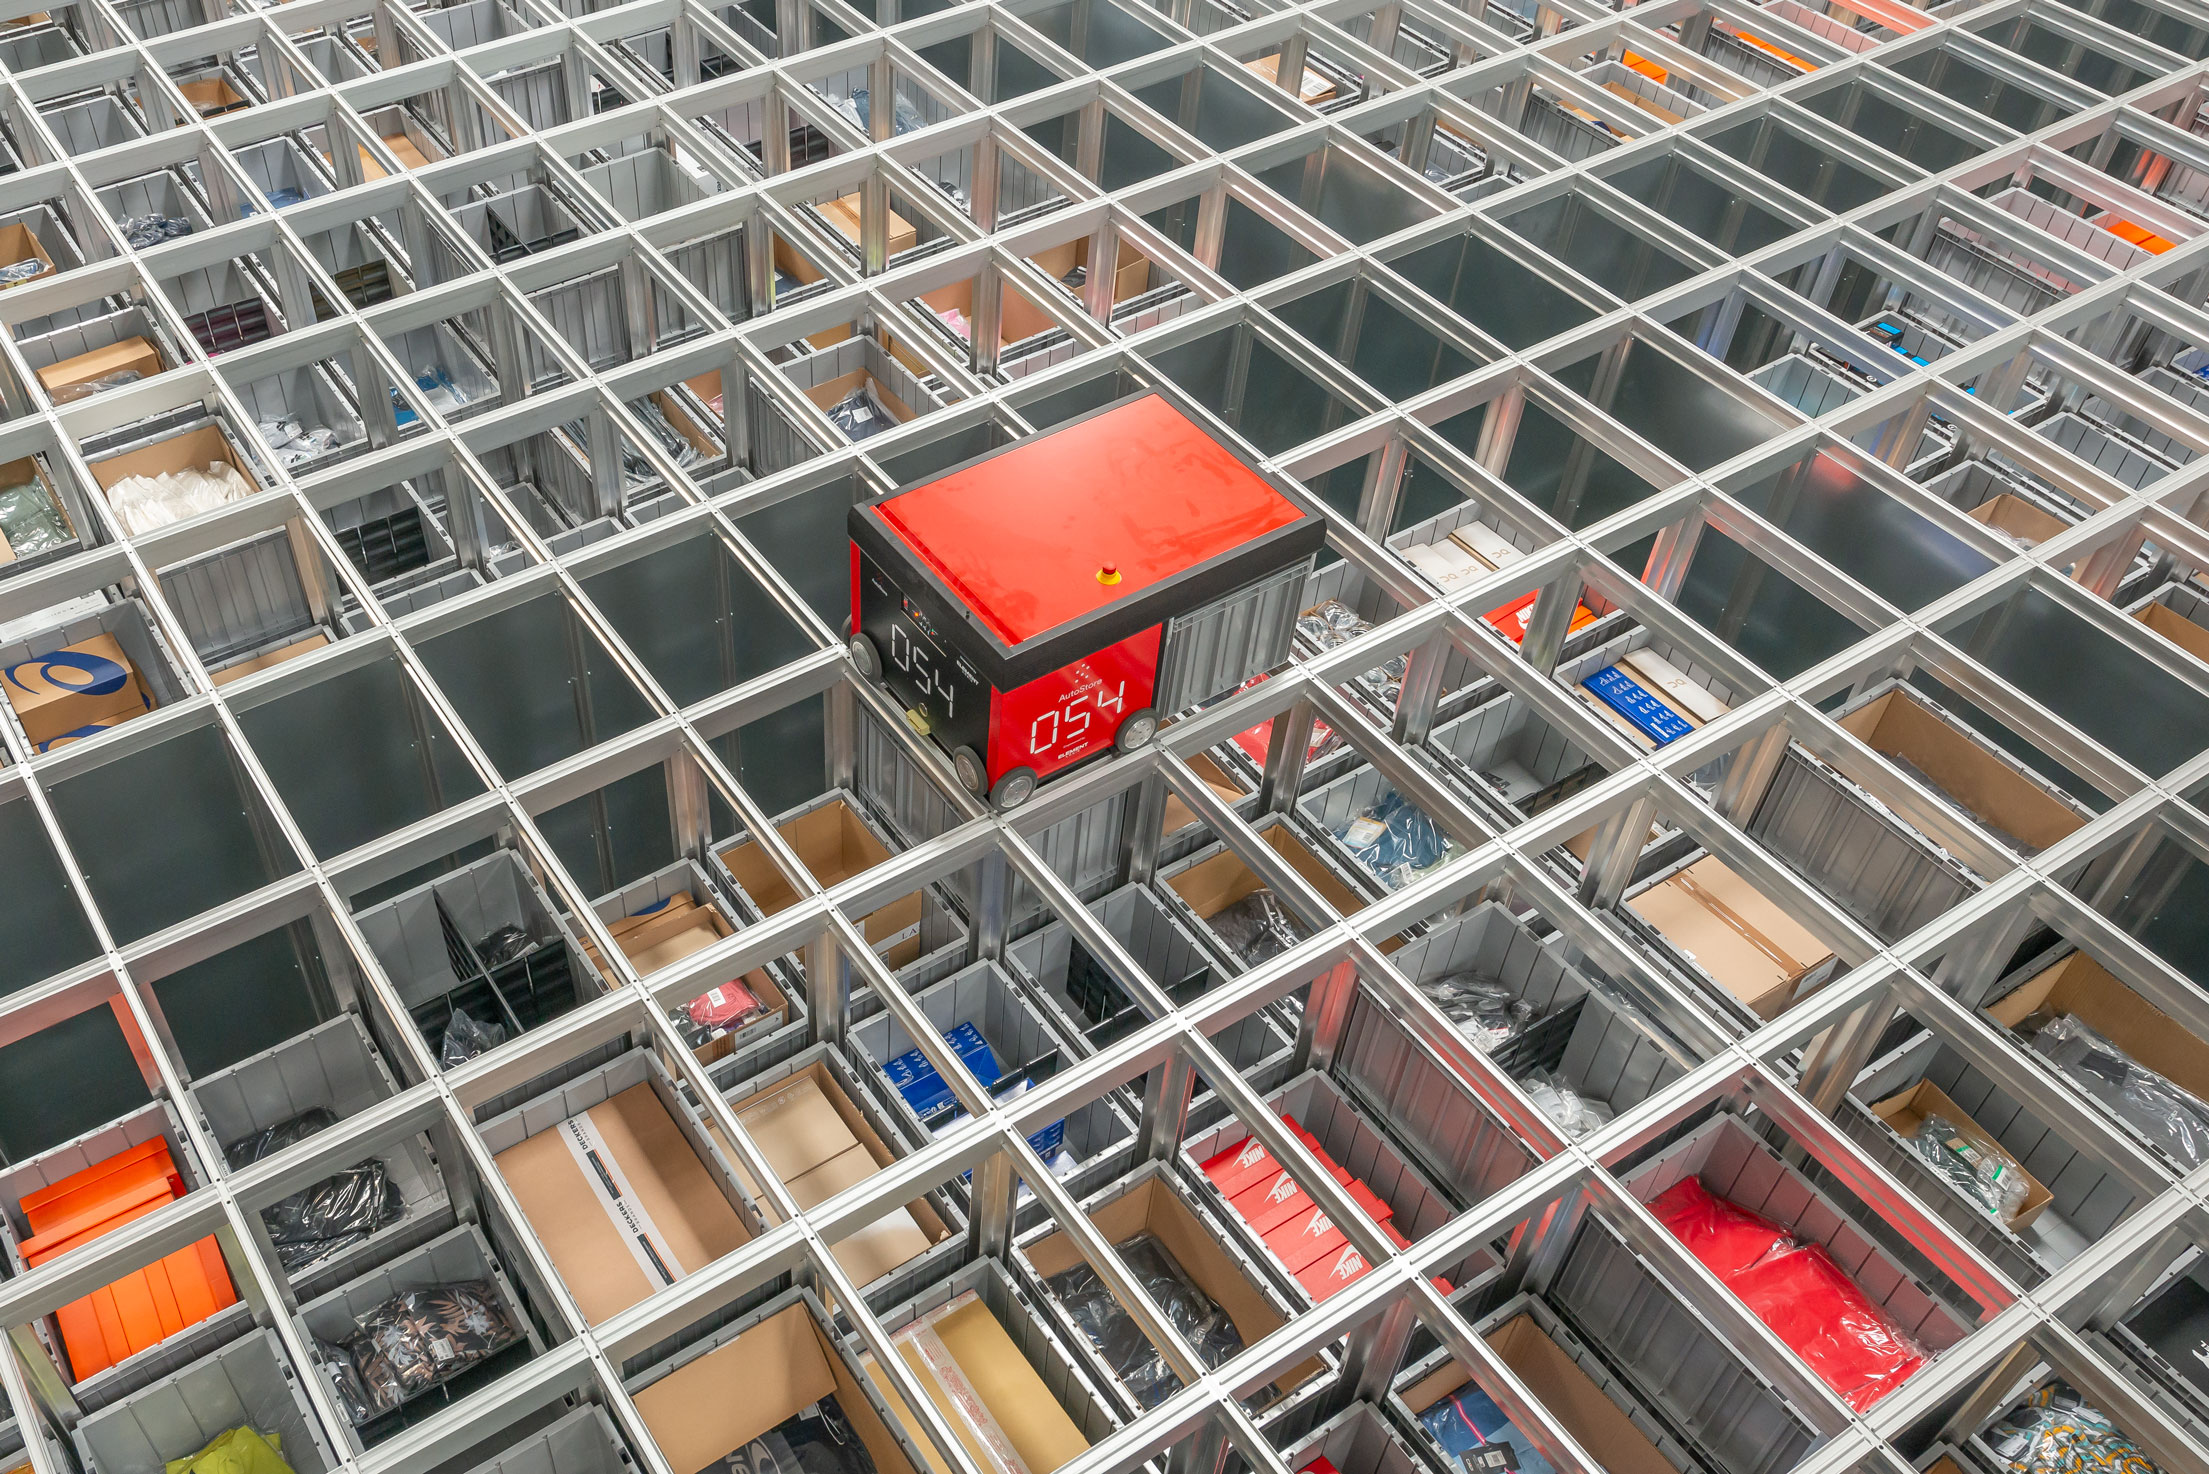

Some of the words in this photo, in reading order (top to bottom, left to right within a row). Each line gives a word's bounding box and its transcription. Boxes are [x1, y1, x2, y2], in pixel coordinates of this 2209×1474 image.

[891, 623, 953, 718] 054
[1058, 678, 1102, 703] AutoStore
[1030, 681, 1125, 754] 054
[1057, 742, 1089, 760] ELEMENT
[567, 1119, 589, 1150] DECKERS
[1243, 1145, 1266, 1169] NIKE
[1274, 1180, 1298, 1204] NIKE
[616, 1201, 639, 1234] DECKERS
[1339, 1255, 1363, 1281] NIKE
